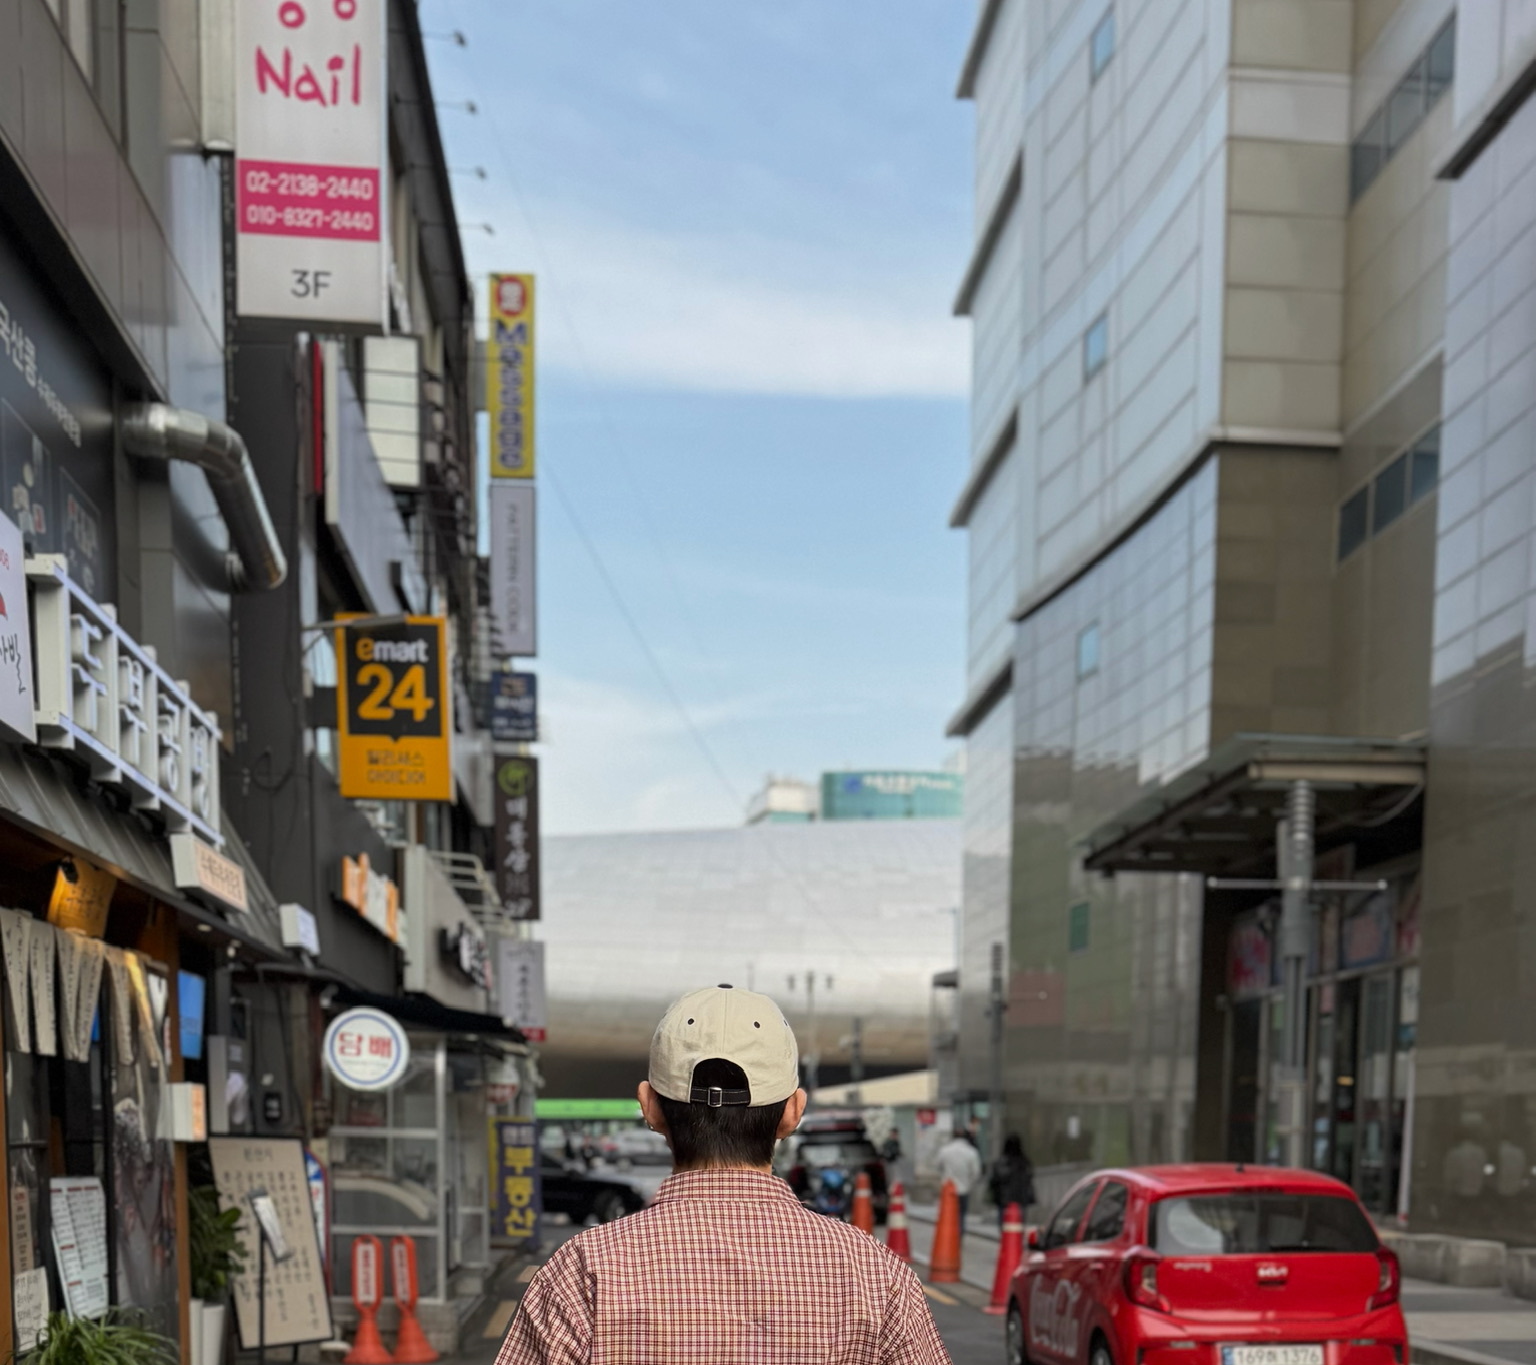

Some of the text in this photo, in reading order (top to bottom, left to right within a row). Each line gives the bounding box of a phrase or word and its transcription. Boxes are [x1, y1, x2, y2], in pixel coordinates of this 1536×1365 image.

[255, 43, 361, 108] Nail
[246, 170, 374, 200] 02-2138-2440
[291, 269, 332, 298] 3F
[355, 638, 429, 662] emart
[356, 664, 435, 722] 24
[504, 1146, 536, 1238] 부동산
[1283, 1347, 1320, 1364] 1376
